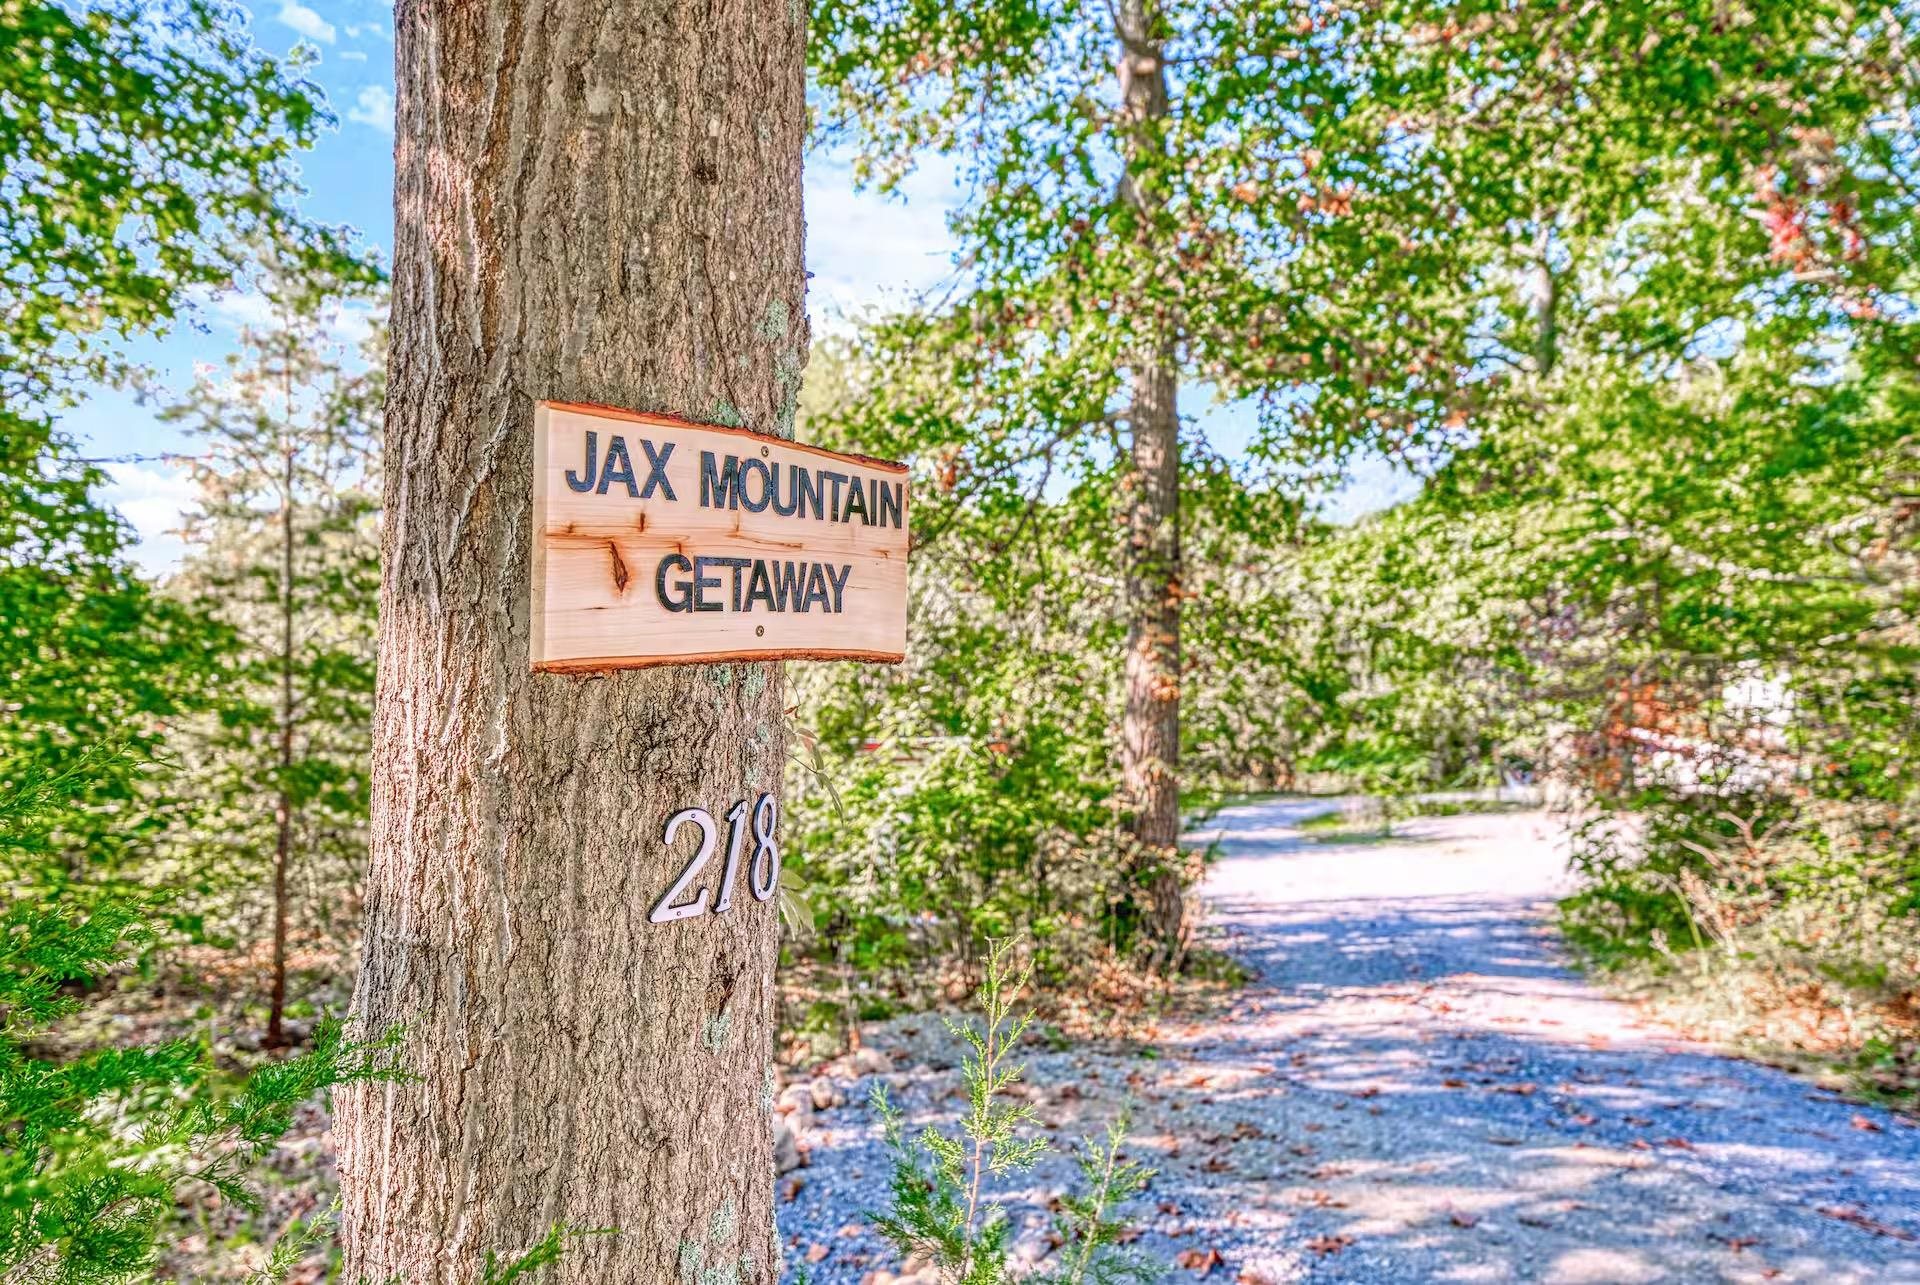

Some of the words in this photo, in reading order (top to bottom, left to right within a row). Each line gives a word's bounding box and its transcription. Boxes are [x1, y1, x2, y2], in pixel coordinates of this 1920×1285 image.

[565, 430, 677, 502] JAX
[700, 449, 903, 530] MOUNTAIN
[656, 553, 852, 614] GETAWAY
[649, 792, 780, 923] 218
